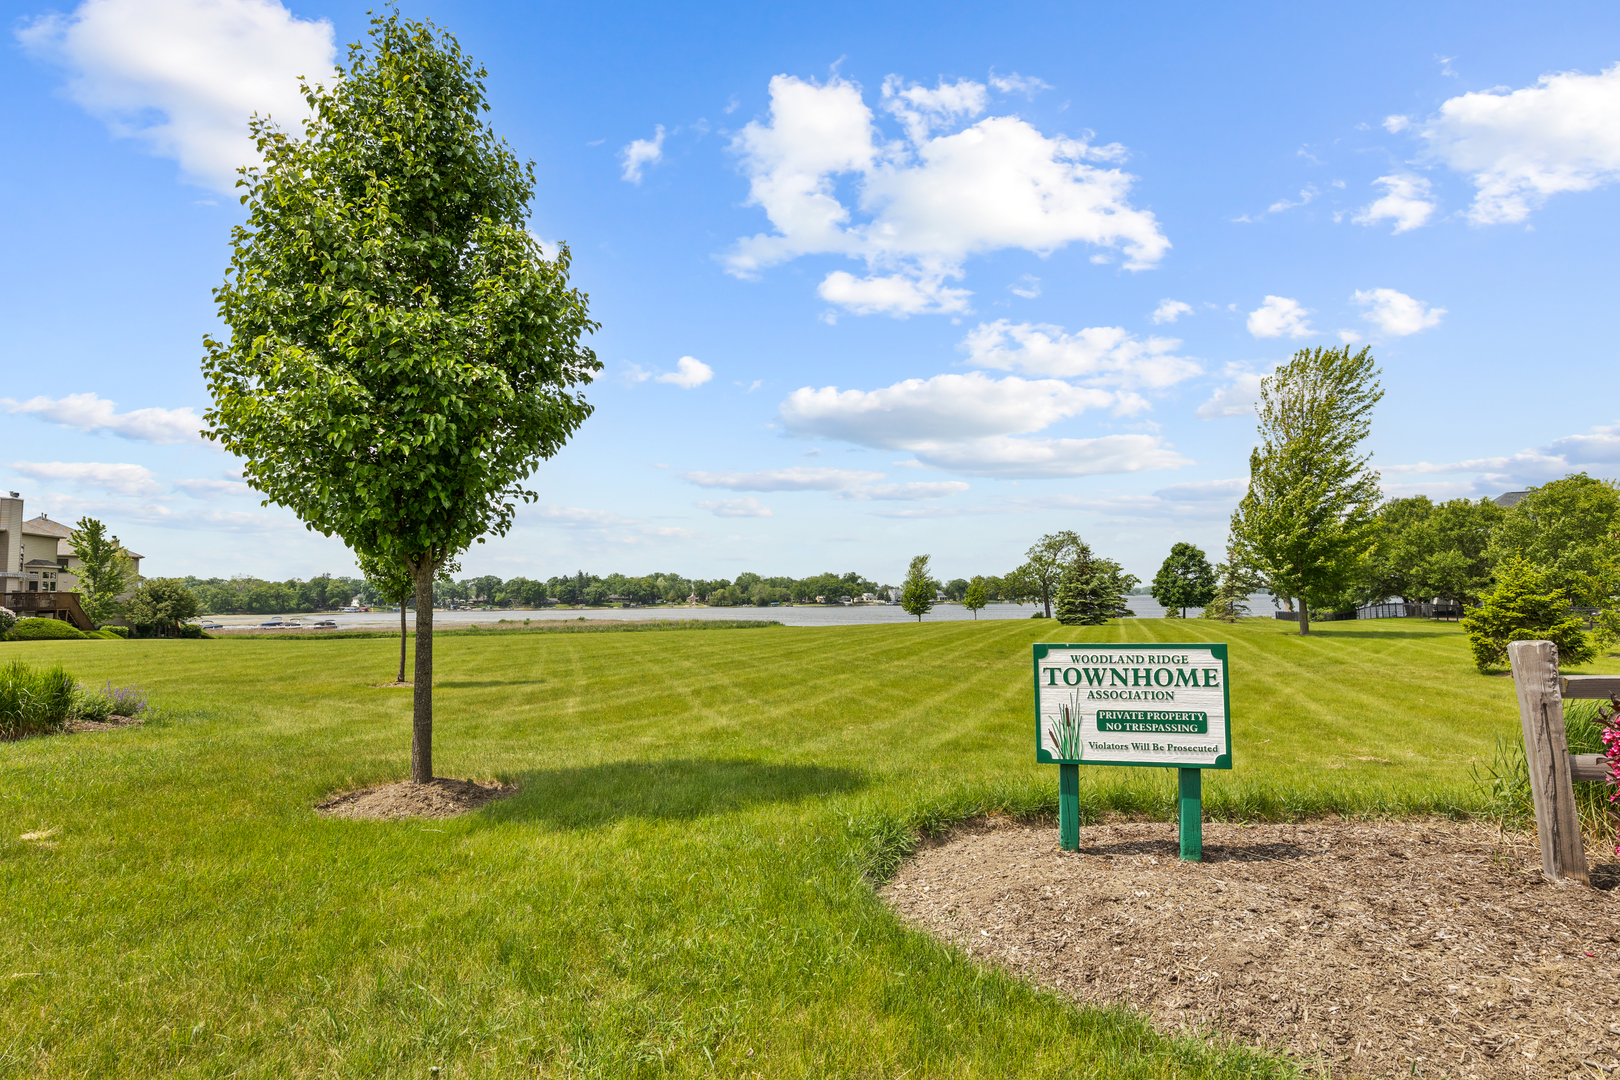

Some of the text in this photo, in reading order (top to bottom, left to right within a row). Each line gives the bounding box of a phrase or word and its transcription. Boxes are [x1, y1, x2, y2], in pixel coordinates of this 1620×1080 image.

[1070, 655, 1189, 664] WOODLAND RIDGE
[1043, 667, 1220, 687] TOWNHOME
[1087, 690, 1175, 700] ASSOCIATION
[1099, 711, 1204, 721] PRIVATE PROPERTY
[1106, 723, 1198, 732] NO TRESPASSING
[1088, 741, 1218, 753] Violators Will Be Prosecuted
